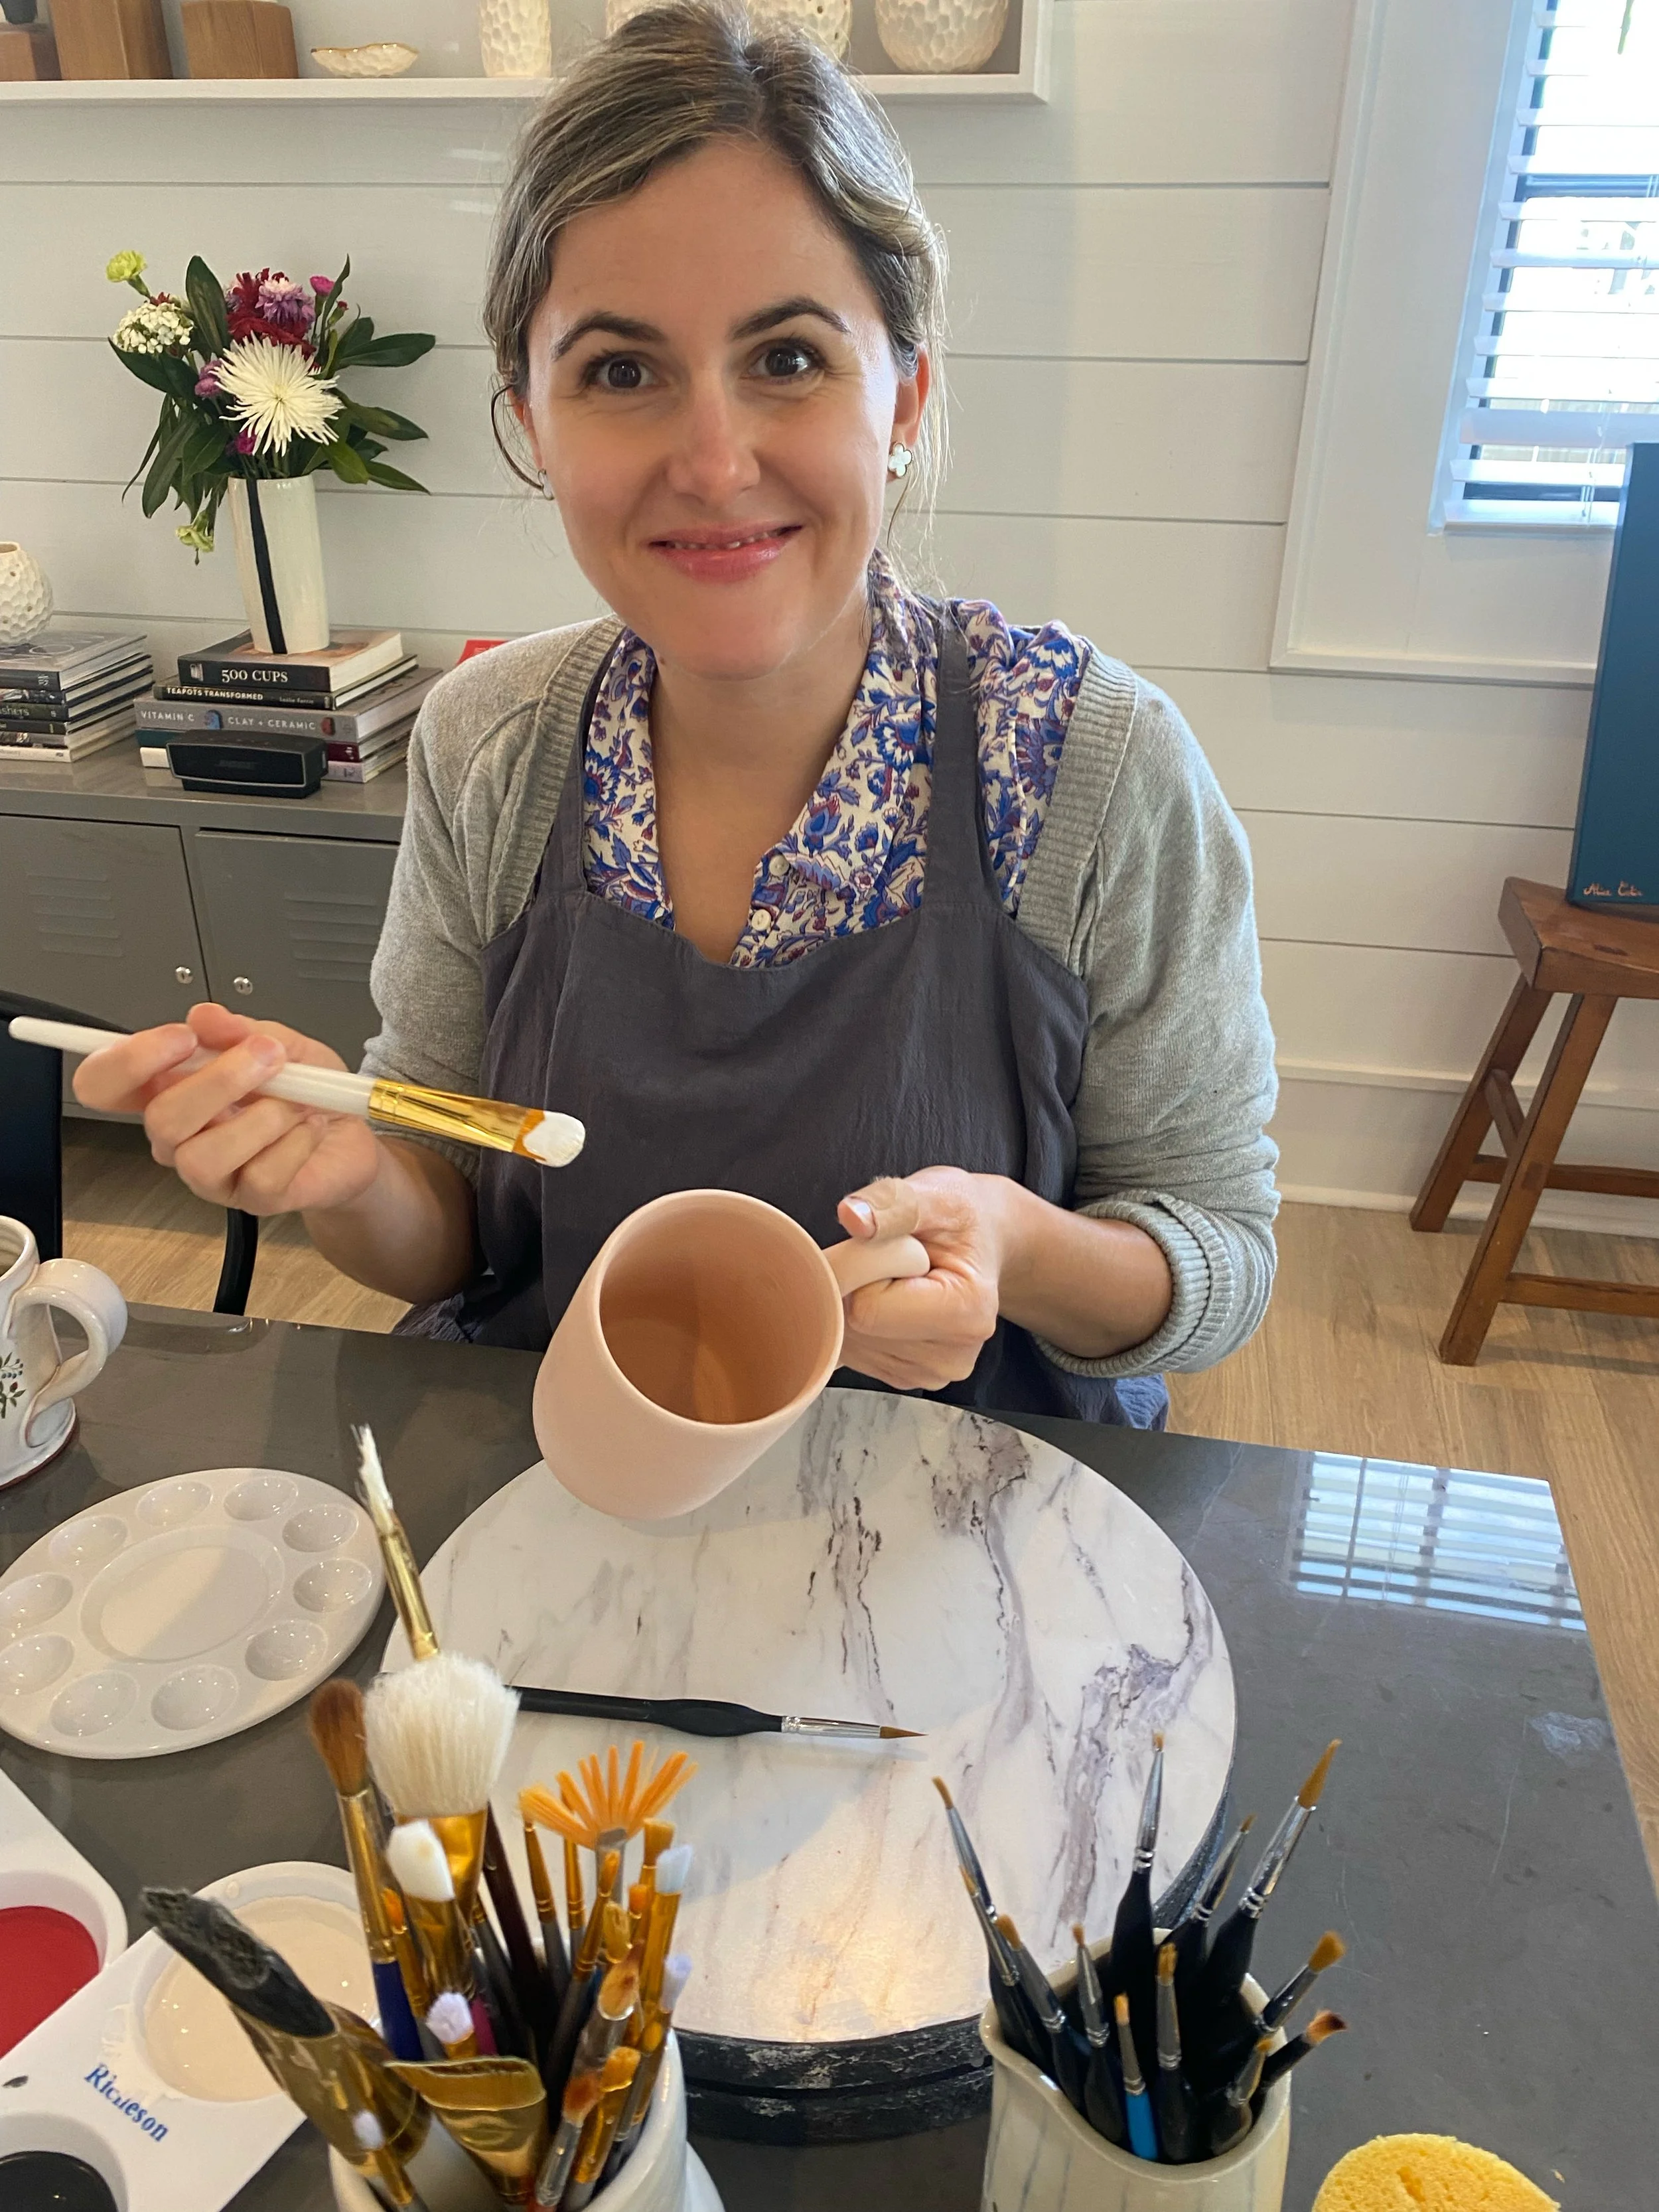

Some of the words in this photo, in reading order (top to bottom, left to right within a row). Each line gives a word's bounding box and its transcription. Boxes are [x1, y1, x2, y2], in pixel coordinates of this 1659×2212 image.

[222, 669, 248, 683] 500
[252, 670, 288, 682] CUPS
[167, 687, 202, 696] TEAPOTS
[204, 690, 263, 700] TRANSFORMED
[140, 710, 184, 721] VITAMIN
[228, 716, 253, 725] CLAY
[267, 719, 316, 730] CERAMIC
